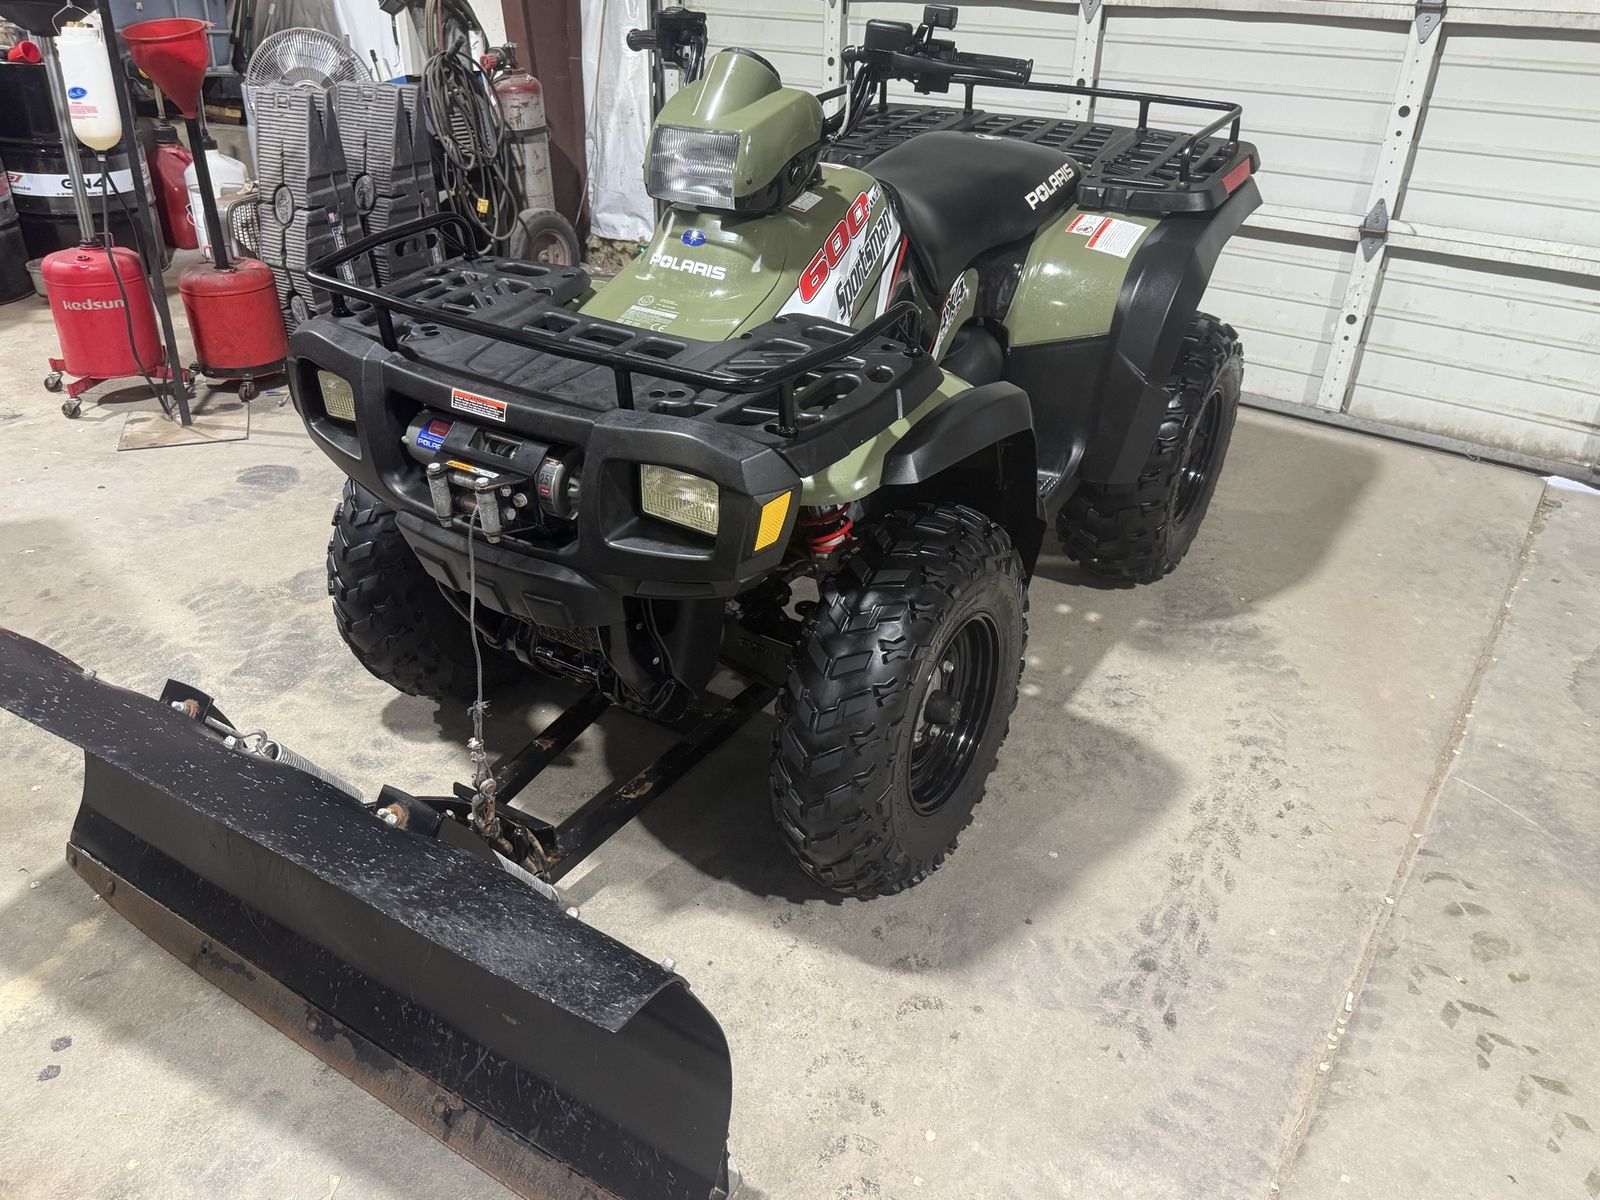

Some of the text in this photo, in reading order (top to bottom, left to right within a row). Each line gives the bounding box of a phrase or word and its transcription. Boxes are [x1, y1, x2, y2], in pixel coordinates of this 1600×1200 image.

[1024, 162, 1075, 211] POLARIS
[649, 253, 727, 281] POLARIS
[798, 191, 870, 304] 600
[835, 207, 893, 320] Sportsman
